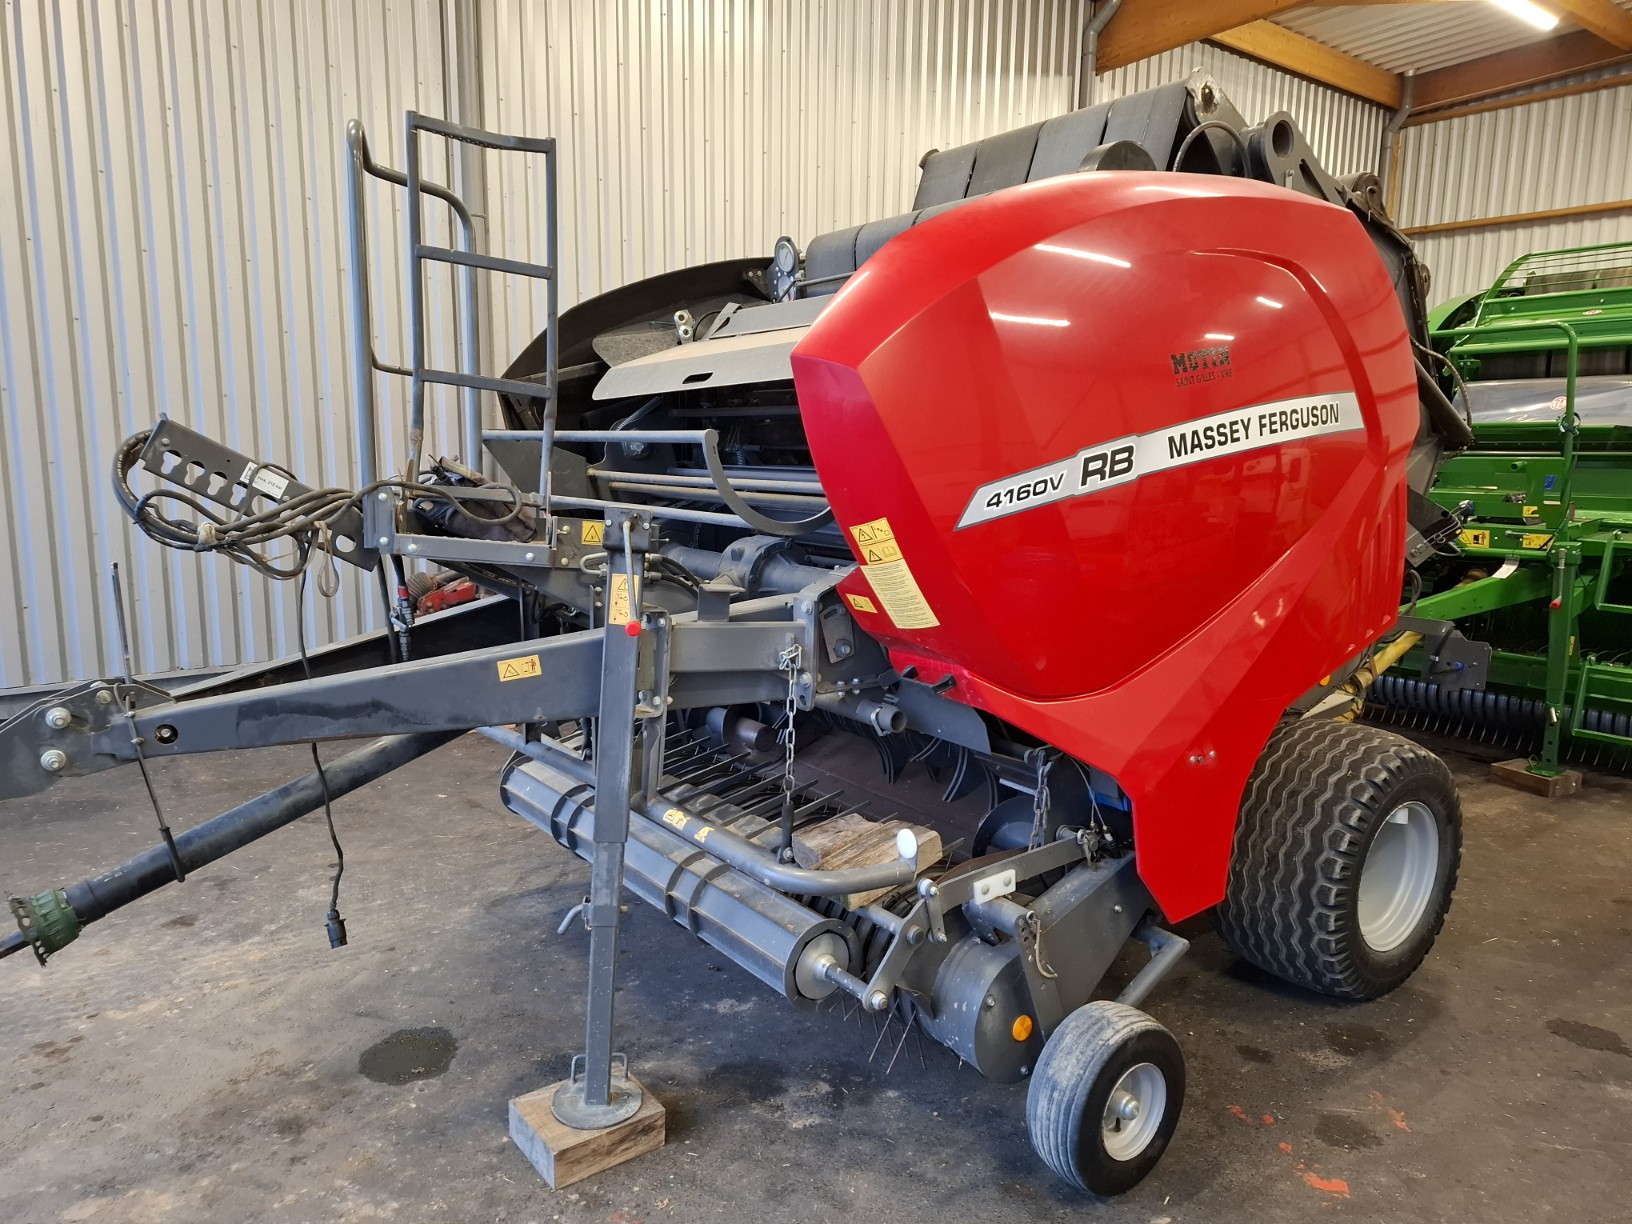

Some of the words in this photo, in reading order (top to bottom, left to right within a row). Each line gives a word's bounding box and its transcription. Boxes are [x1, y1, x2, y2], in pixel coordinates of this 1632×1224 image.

[986, 473, 1064, 508] 4160V
[1080, 445, 1135, 487] RB
[1167, 417, 1252, 459] MASSEY
[1258, 403, 1339, 437] FERGUSON
